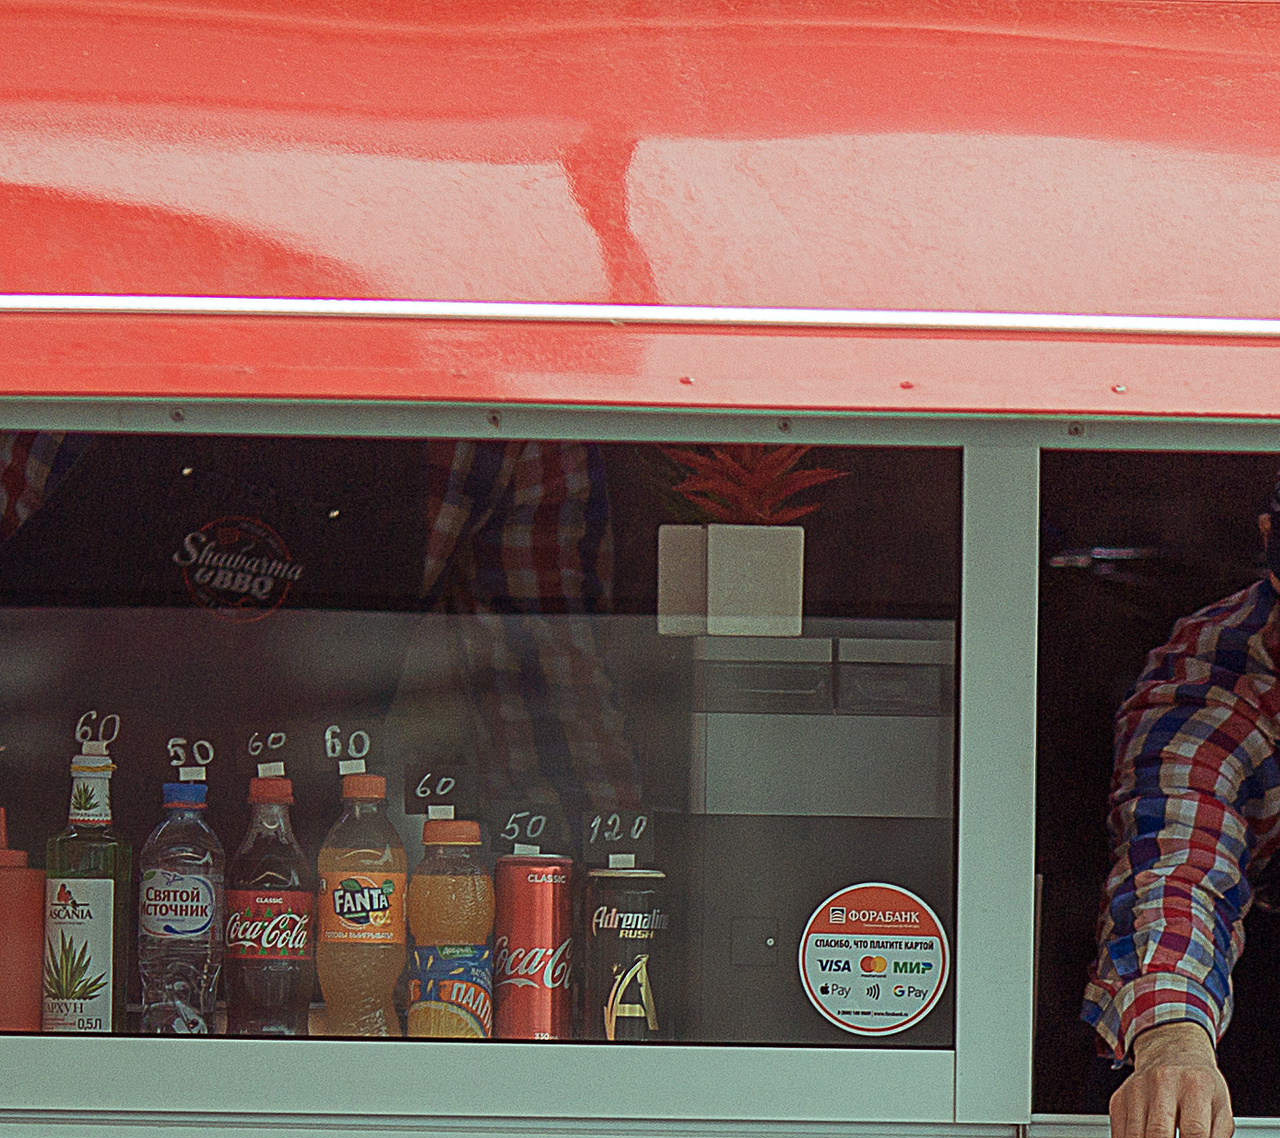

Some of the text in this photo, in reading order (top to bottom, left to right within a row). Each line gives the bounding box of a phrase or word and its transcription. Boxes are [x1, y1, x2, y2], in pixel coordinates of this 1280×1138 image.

[75, 710, 120, 743] 60
[167, 737, 214, 766] 50
[249, 732, 286, 756] 60
[325, 725, 370, 758] 60
[415, 773, 455, 797] 60
[501, 812, 546, 840] 50
[590, 813, 648, 843] 120
[527, 874, 566, 884] CLASSIC
[334, 888, 388, 913] FANTA
[848, 909, 920, 923] ФОРАБАНК
[225, 912, 310, 948] Coca-Cola
[619, 930, 654, 939] RUSH
[815, 939, 934, 951] СПАСИБО, ЧТО ПЛАТИТЕ КАРТОЙ
[817, 959, 851, 972] VISA
[893, 961, 933, 974] МИР
[831, 984, 851, 999] Pay
